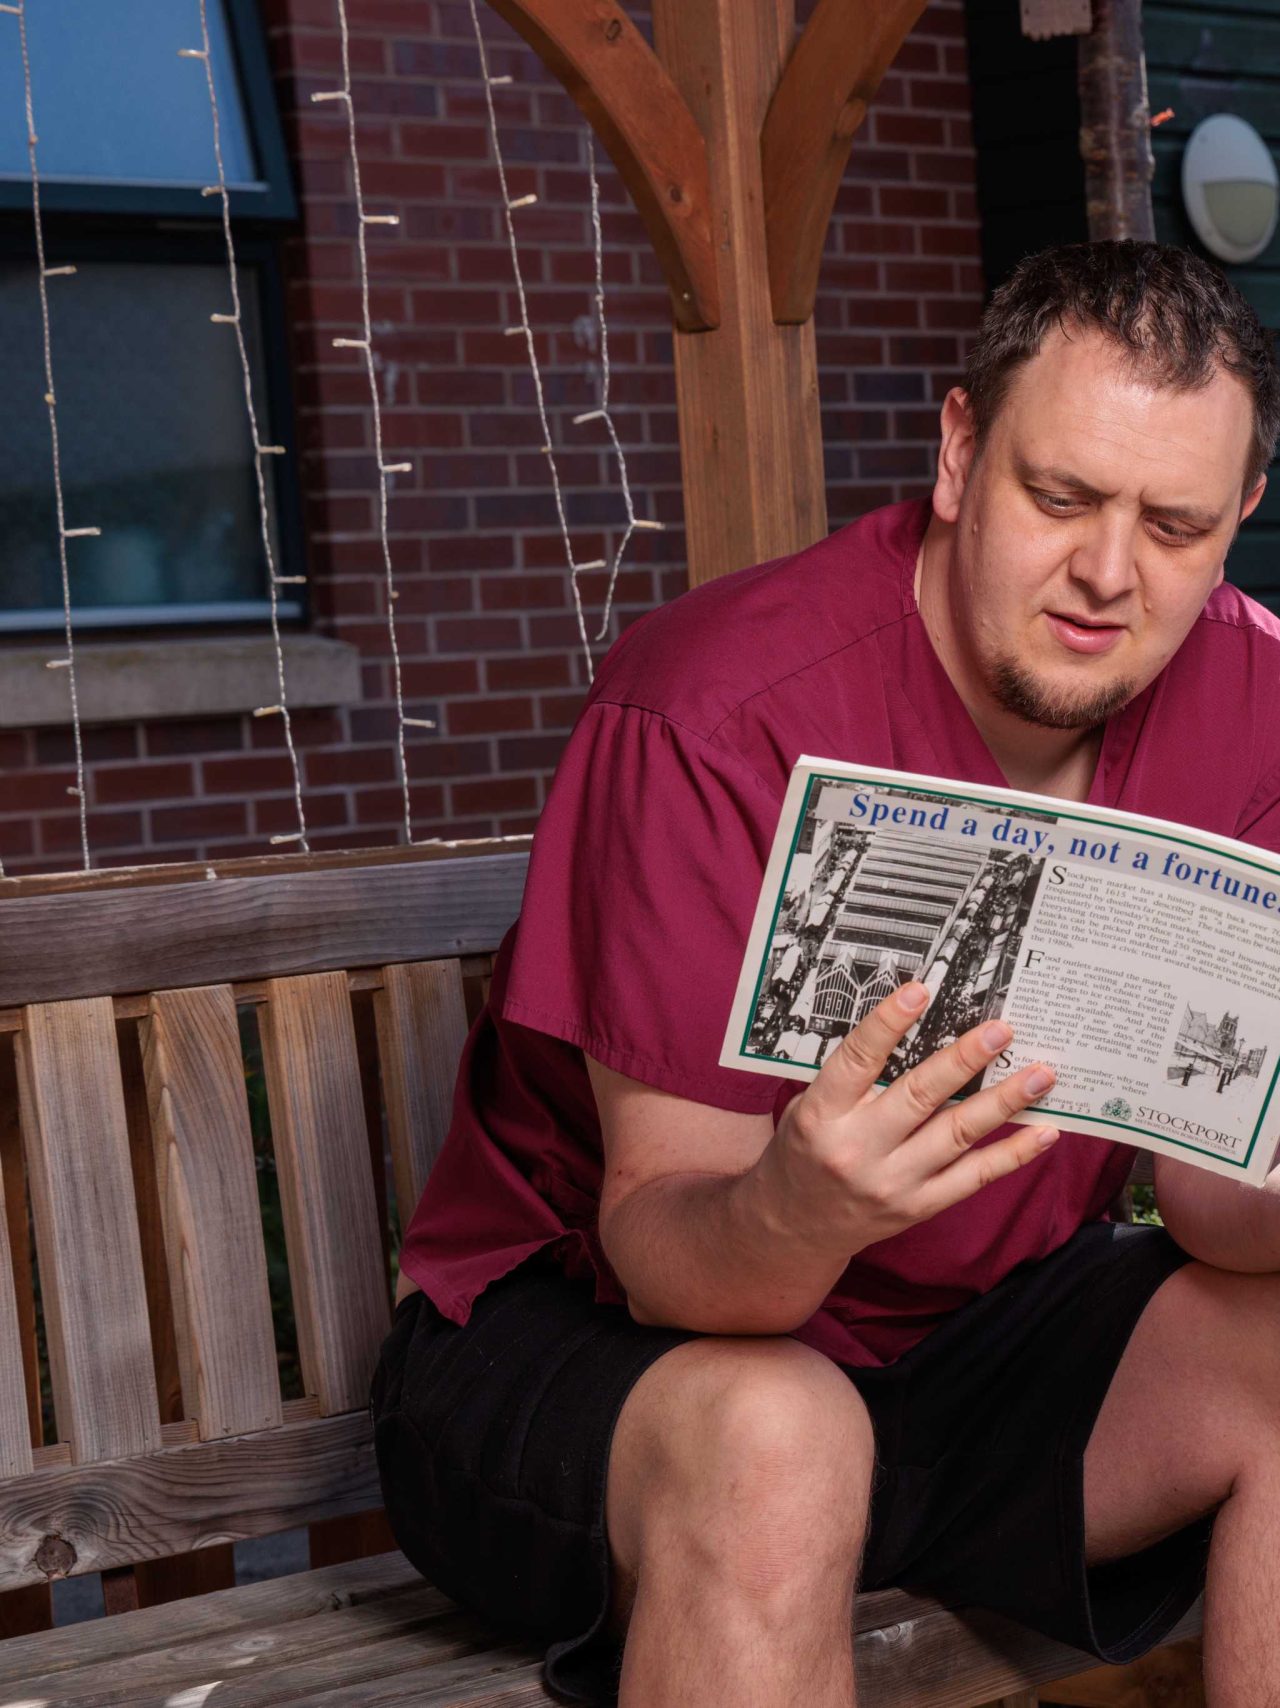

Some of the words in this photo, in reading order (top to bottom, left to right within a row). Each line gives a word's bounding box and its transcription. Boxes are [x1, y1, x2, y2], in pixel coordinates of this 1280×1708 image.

[849, 793, 949, 830] Spend
[961, 818, 977, 836] a
[992, 818, 1054, 856] day,
[1068, 837, 1122, 863] not
[1132, 851, 1149, 870] a
[1042, 894, 1091, 910] particularly
[1109, 906, 1150, 922] Tuesday's
[1152, 917, 1168, 927] flea
[1045, 884, 1092, 900] frequented
[1106, 897, 1141, 911] dwellers
[1142, 905, 1155, 914] far
[1198, 921, 1213, 932] The
[1214, 928, 1236, 939] same
[1236, 936, 1251, 945] can
[1049, 866, 1103, 884] Stockport
[1106, 880, 1136, 892] market
[1140, 887, 1155, 896] has
[1167, 894, 1196, 908] history
[1199, 904, 1223, 918] going
[1226, 912, 1245, 924] back
[1249, 922, 1267, 932] over
[1068, 881, 1085, 889] and
[1106, 888, 1126, 898] 1615
[1132, 895, 1148, 904] was
[1153, 900, 1194, 916] described
[1227, 923, 1249, 935] great
[1031, 934, 1045, 943] the
[1033, 926, 1069, 940] building
[1071, 934, 1088, 943] that
[1091, 939, 1109, 948] won
[1119, 946, 1137, 955] civic
[1141, 950, 1161, 961] trust
[1164, 957, 1190, 969] award
[1192, 965, 1214, 977] when
[1225, 977, 1241, 987] was
[1036, 918, 1057, 928] stalls
[1071, 925, 1085, 934] the
[1088, 928, 1127, 943] Victorian
[1129, 939, 1159, 952] market
[1161, 946, 1178, 957] hall
[1198, 959, 1238, 976] attractive
[1240, 972, 1258, 983] iron
[1260, 980, 1276, 990] and
[1038, 909, 1067, 921] knacks
[1070, 917, 1085, 925] can
[1103, 924, 1131, 936] picked
[1149, 934, 1170, 946] from
[1173, 941, 1190, 951] 250
[1192, 948, 1213, 959] open
[1216, 955, 1229, 964] air
[1231, 961, 1252, 972] stalls
[1040, 901, 1086, 918] Everything
[1089, 911, 1110, 921] from
[1113, 916, 1134, 927] fresh
[1137, 923, 1171, 938] produce
[1187, 937, 1216, 951] clothes
[1219, 948, 1235, 957] and
[1238, 953, 1280, 974] household
[1021, 967, 1057, 980] market's
[1093, 983, 1111, 992] with
[1113, 988, 1141, 999] choice
[1143, 996, 1175, 1010] ranging
[1022, 950, 1062, 968] Food
[1062, 959, 1092, 970] outlets
[1093, 966, 1124, 978] around
[1126, 973, 1140, 982] the
[1141, 978, 1171, 990] market
[1083, 973, 1118, 987] exciting
[1124, 982, 1142, 992] part
[1163, 992, 1178, 1001] the
[1013, 995, 1040, 1004] ample
[1044, 1000, 1071, 1010] spaces
[1125, 1016, 1143, 1026] And
[1146, 1021, 1167, 1033] bank
[1016, 986, 1050, 998] parking
[1056, 993, 1080, 1003] poses
[1103, 1003, 1145, 1018] problems
[1151, 1014, 1170, 1025] with
[1018, 976, 1039, 986] from
[1041, 980, 1077, 994] hot-dogs
[1090, 990, 1102, 999] ice
[1137, 1001, 1157, 1013] Even
[1159, 1009, 1174, 1017] car
[1007, 1020, 1061, 1034] accompanied
[1081, 1033, 1132, 1051] entertaining
[1136, 1046, 1159, 1057] street
[1009, 1012, 1045, 1022] market's
[1050, 1018, 1078, 1029] special
[1083, 1024, 1110, 1035] theme
[1140, 1038, 1162, 1049] often
[1011, 1001, 1048, 1014] holidays
[1055, 1010, 1085, 1022] usually
[1093, 1018, 1106, 1026] see
[1112, 1023, 1129, 1031] one
[1151, 1032, 1165, 1041] the
[1043, 1034, 1071, 1045] (check
[1076, 1040, 1089, 1048] for
[1094, 1044, 1122, 1055] details
[1143, 1056, 1158, 1065] the
[1070, 1066, 1114, 1080] remember,
[1116, 1075, 1133, 1085] why
[1135, 1080, 1149, 1089] not
[1073, 1083, 1087, 1091] not
[1121, 1085, 1147, 1096] where
[1137, 1106, 1242, 1148] STOCKPORT
